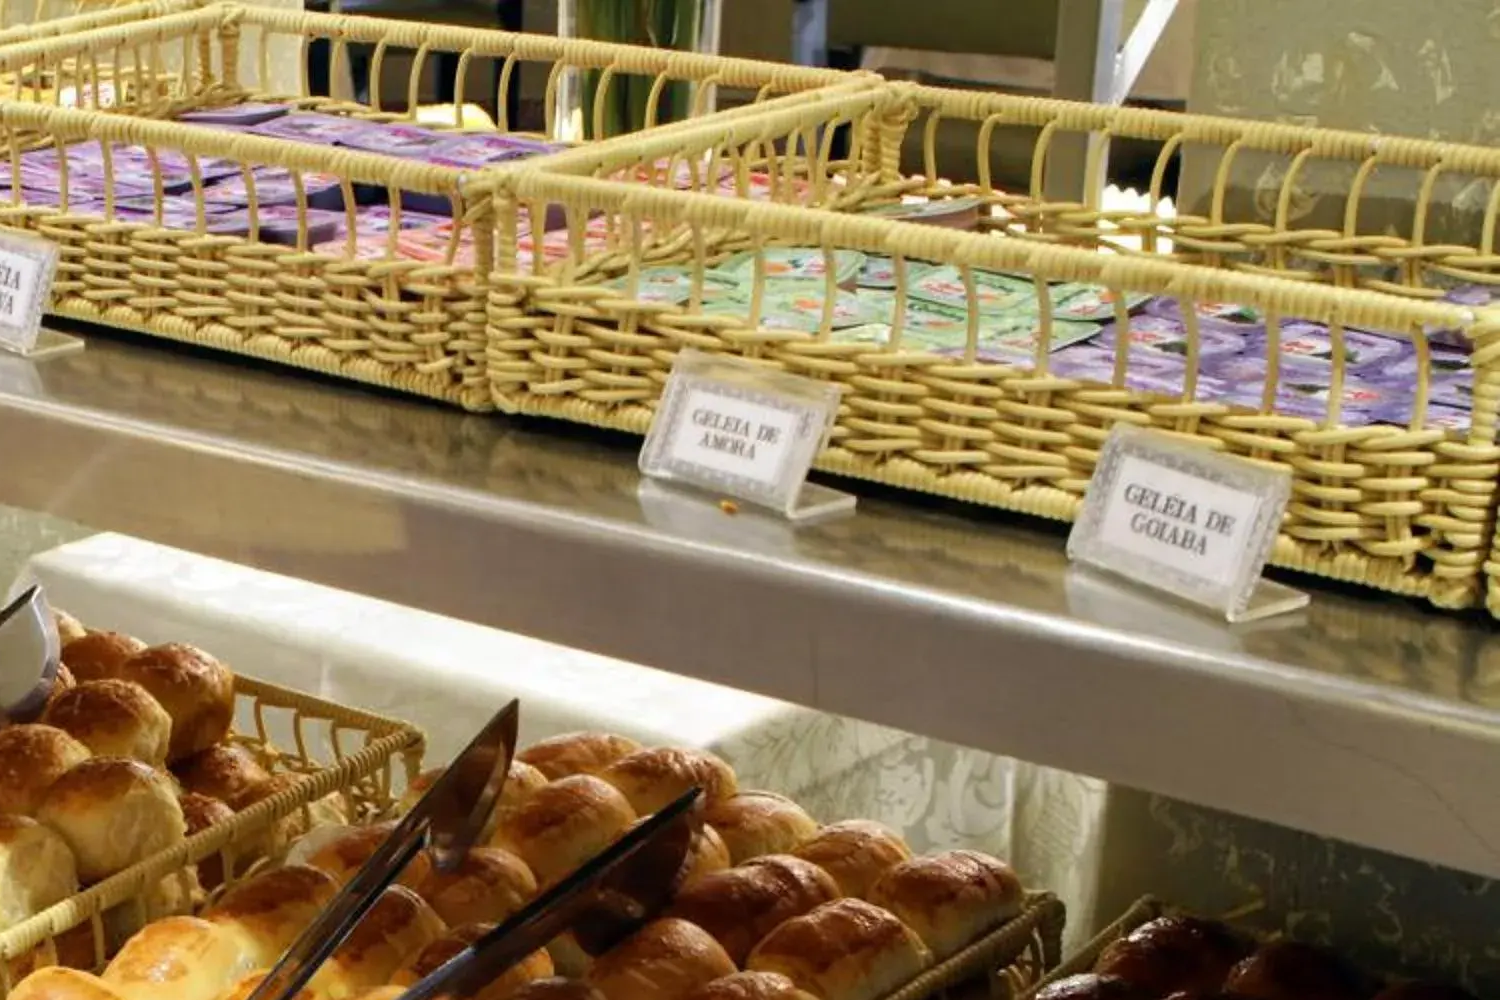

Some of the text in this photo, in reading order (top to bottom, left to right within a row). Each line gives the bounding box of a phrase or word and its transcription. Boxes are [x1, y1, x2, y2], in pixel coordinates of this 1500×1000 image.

[757, 423, 782, 445] DE
[1130, 511, 1208, 556] GOIABA
[1205, 508, 1237, 537] DE
